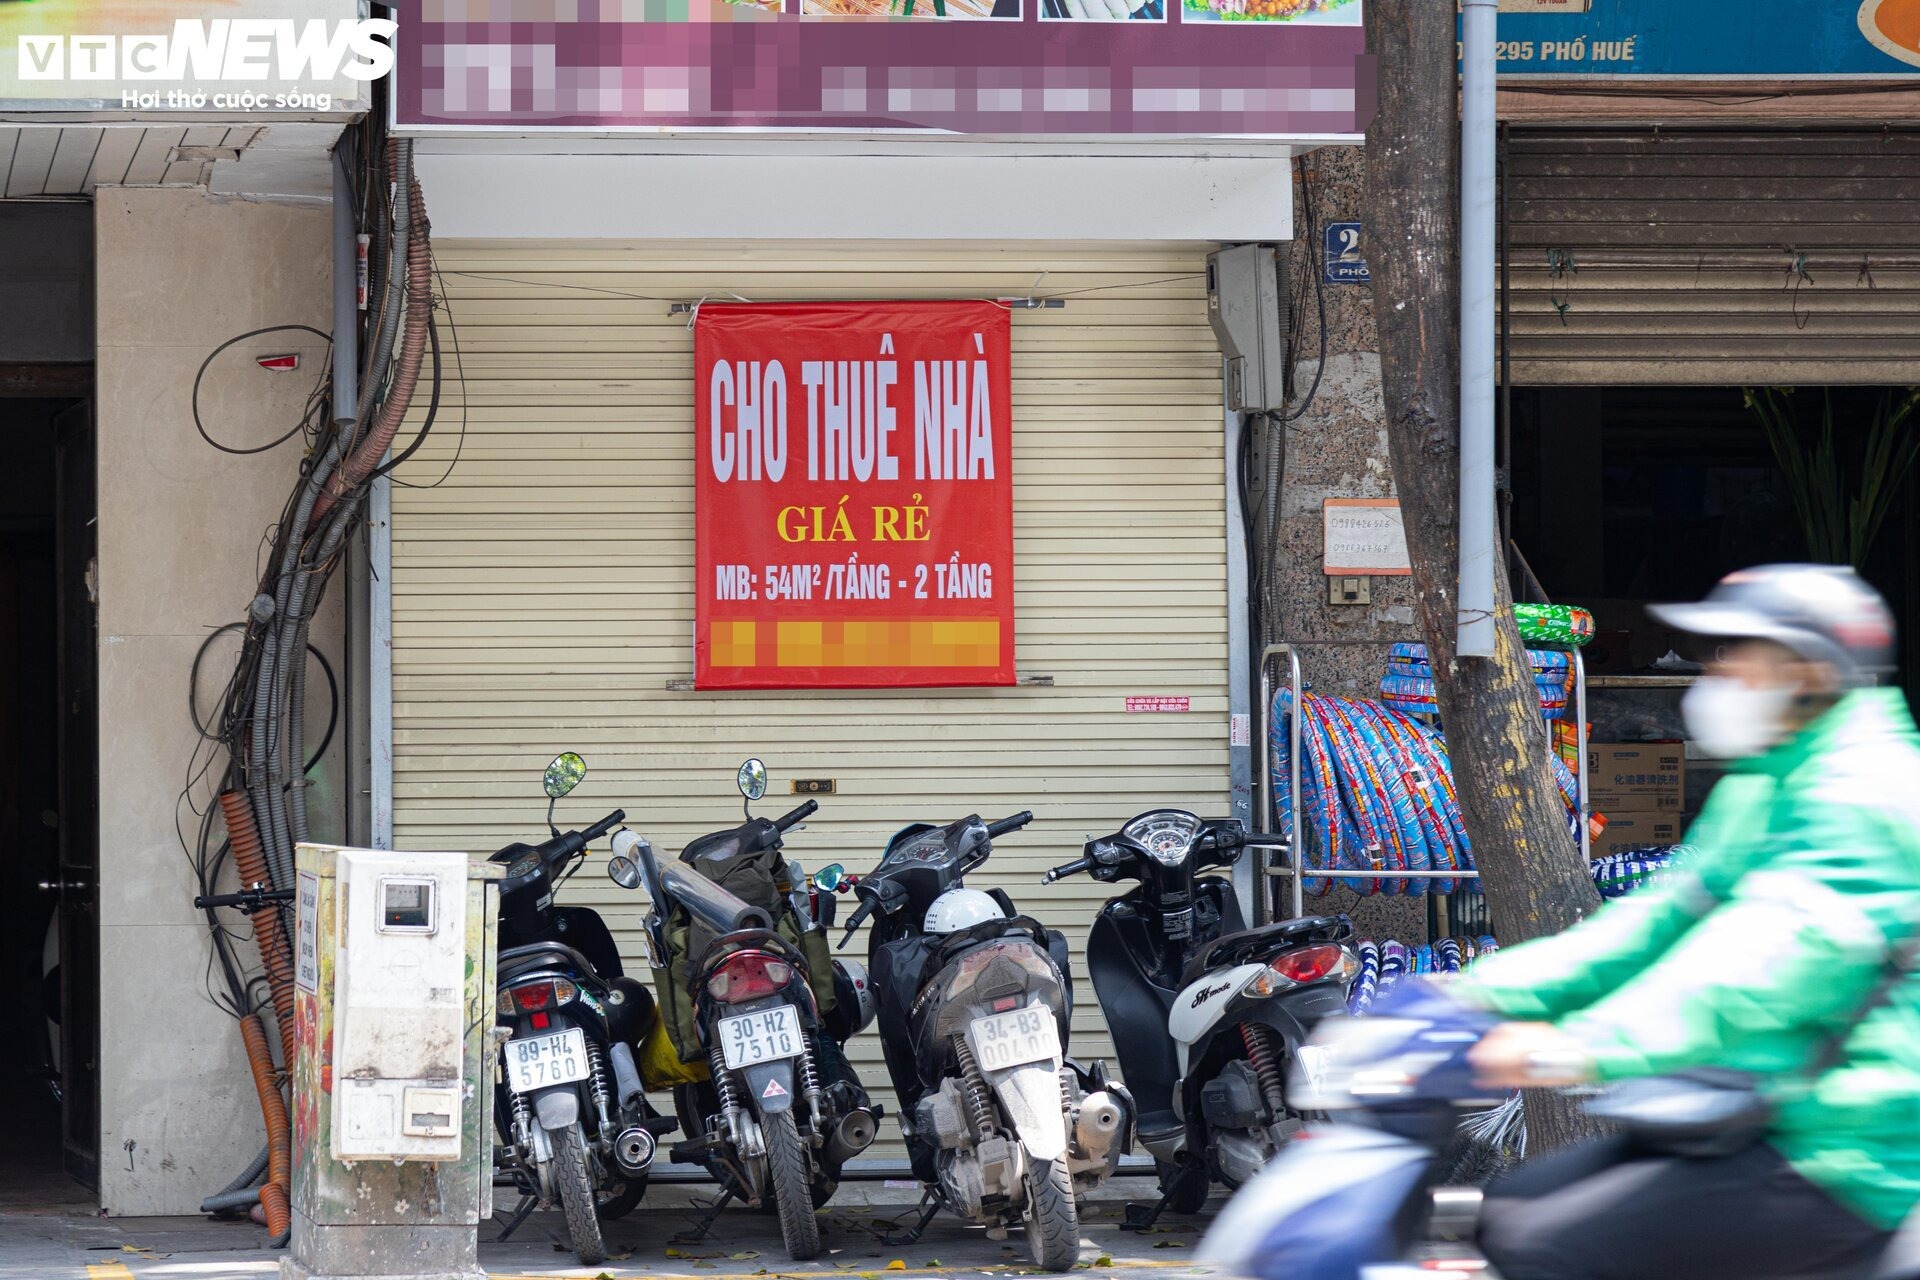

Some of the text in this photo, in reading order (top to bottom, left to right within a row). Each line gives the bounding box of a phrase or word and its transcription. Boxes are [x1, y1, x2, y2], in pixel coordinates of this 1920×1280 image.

[1495, 35, 1637, 61] 295 PHỐ HUẾ
[711, 333, 995, 482] CHO THUÊ NHÀ
[777, 492, 931, 542] GIÁ RẺ
[716, 565, 758, 600] MB:
[914, 564, 928, 599] 2
[935, 551, 992, 599] TẦNG
[1209, 981, 1231, 997] mode
[731, 1011, 785, 1040] 30-H2
[983, 1011, 1041, 1042] 34-B3
[518, 1034, 573, 1063] 89-H4
[735, 1033, 791, 1063] 7510
[520, 1057, 577, 1086] 5760
